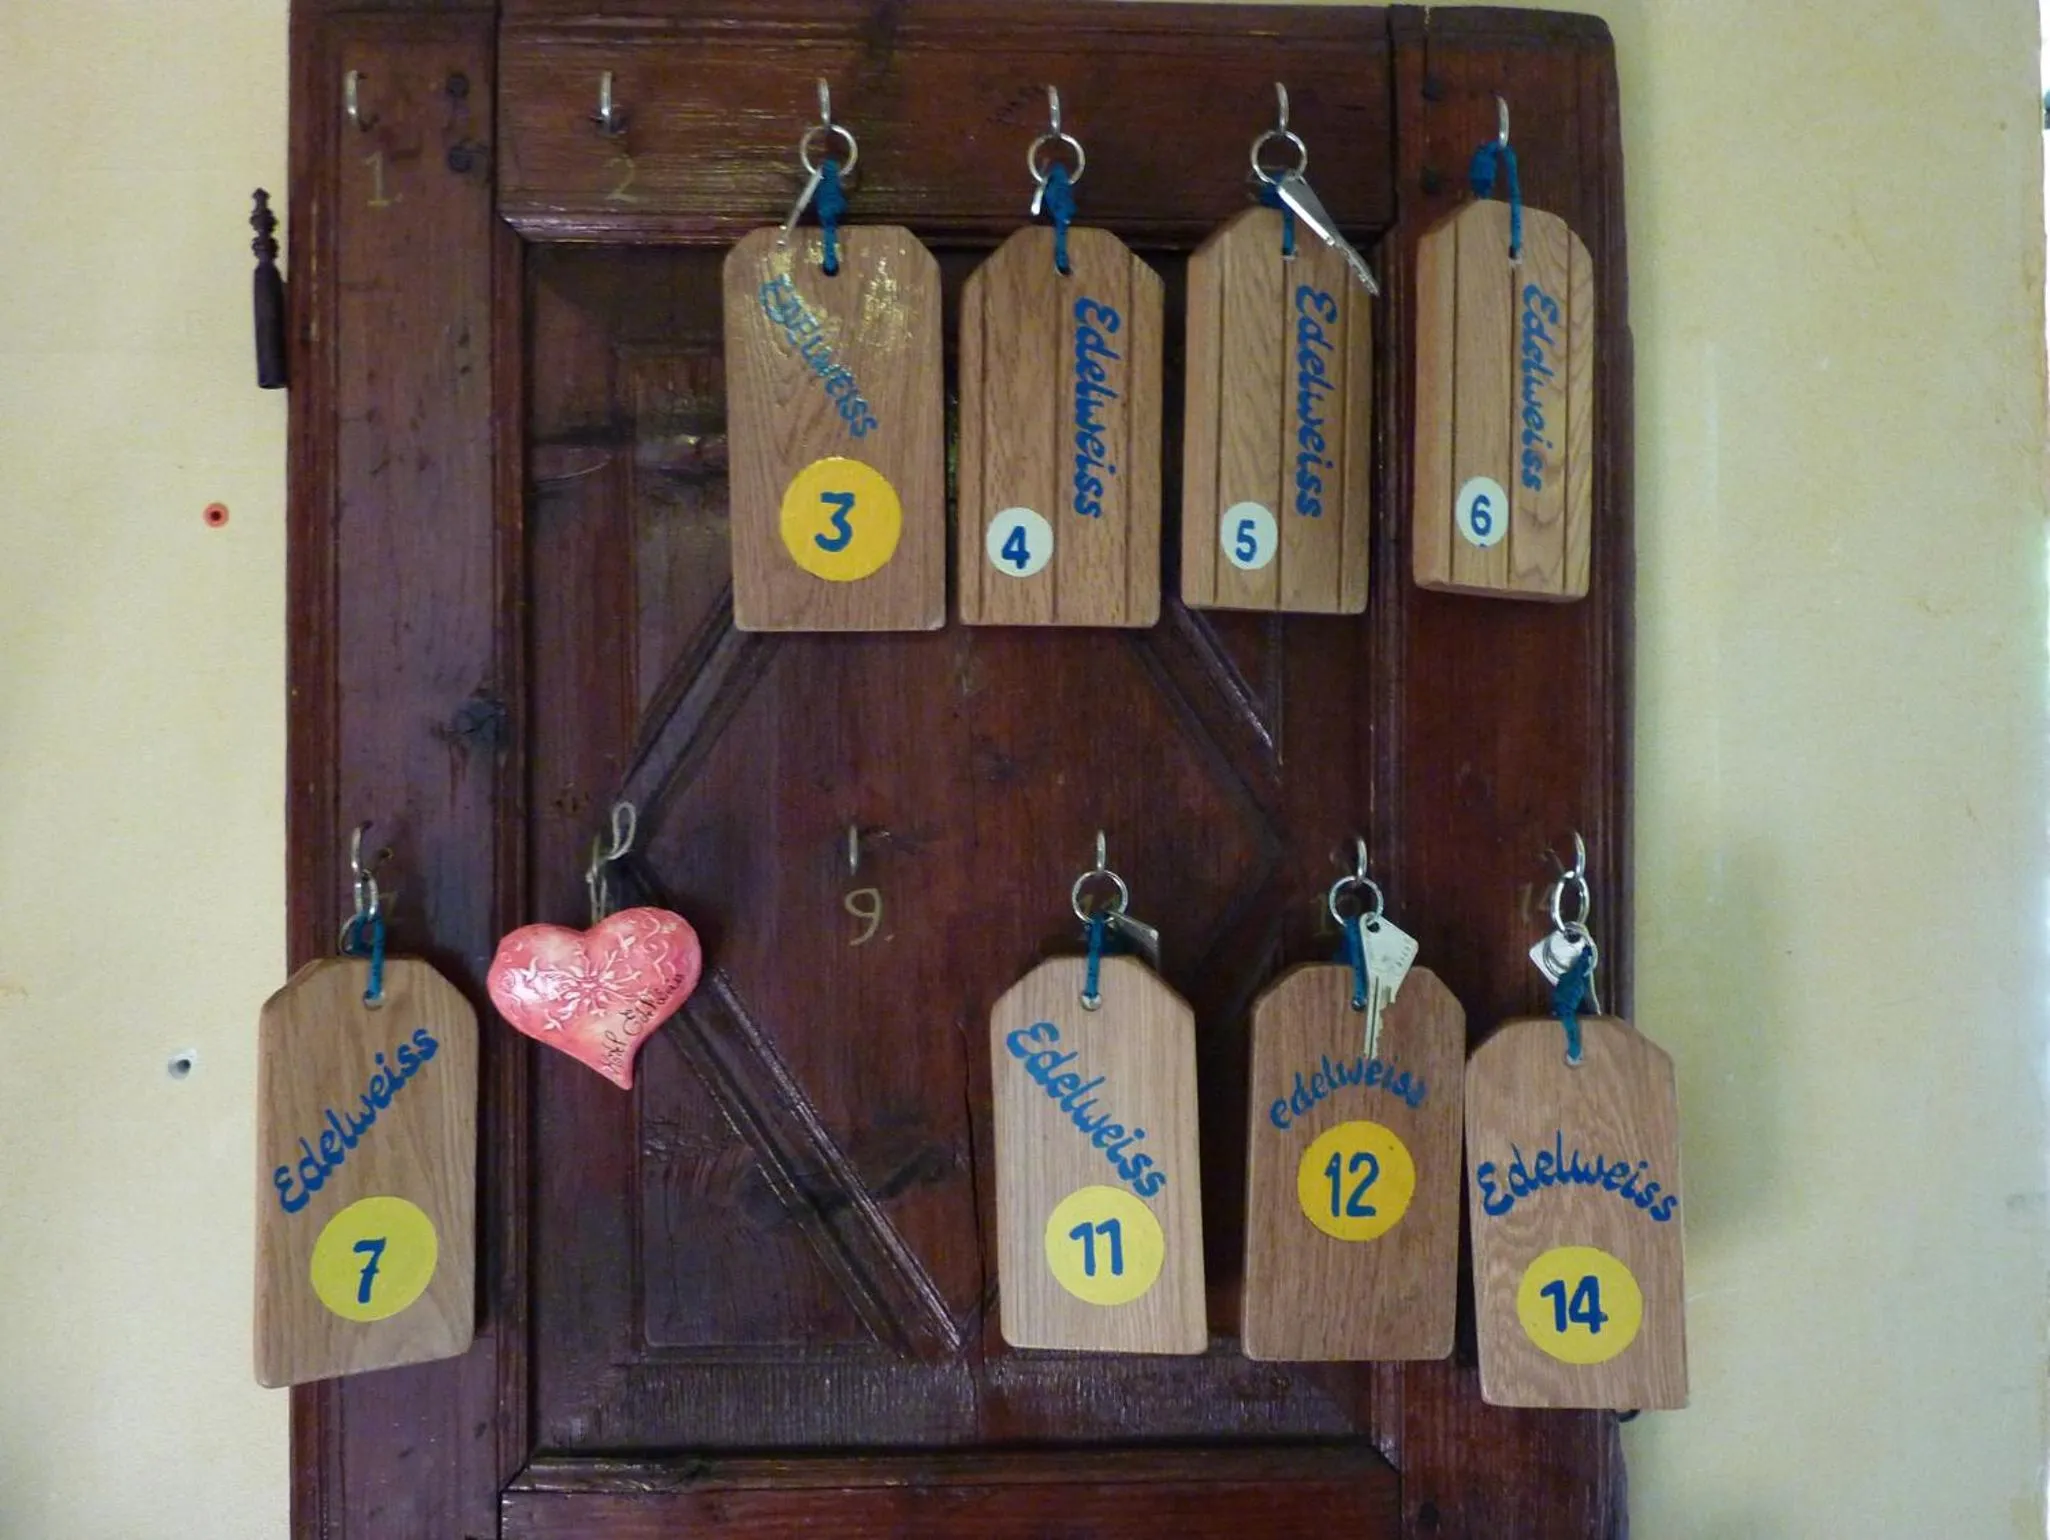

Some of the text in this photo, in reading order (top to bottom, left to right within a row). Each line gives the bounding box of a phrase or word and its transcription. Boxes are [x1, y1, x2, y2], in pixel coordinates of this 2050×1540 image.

[604, 154, 638, 202] 2
[1073, 296, 1121, 519] Edelweiss
[1294, 284, 1338, 519] Edelweiss
[1520, 283, 1560, 493] Edelweiss
[814, 491, 855, 552] 3
[1000, 524, 1031, 571] 4
[1234, 518, 1258, 563] 5
[1469, 493, 1493, 537] 6
[273, 1028, 438, 1214] Edelweiss
[1006, 1021, 1166, 1199] Edelweiss
[1324, 1151, 1379, 1218] 12
[1476, 1131, 1679, 1223] Edelweiss
[352, 1238, 387, 1304] 7
[1070, 1217, 1124, 1277] 11
[1539, 1275, 1609, 1335] 14
